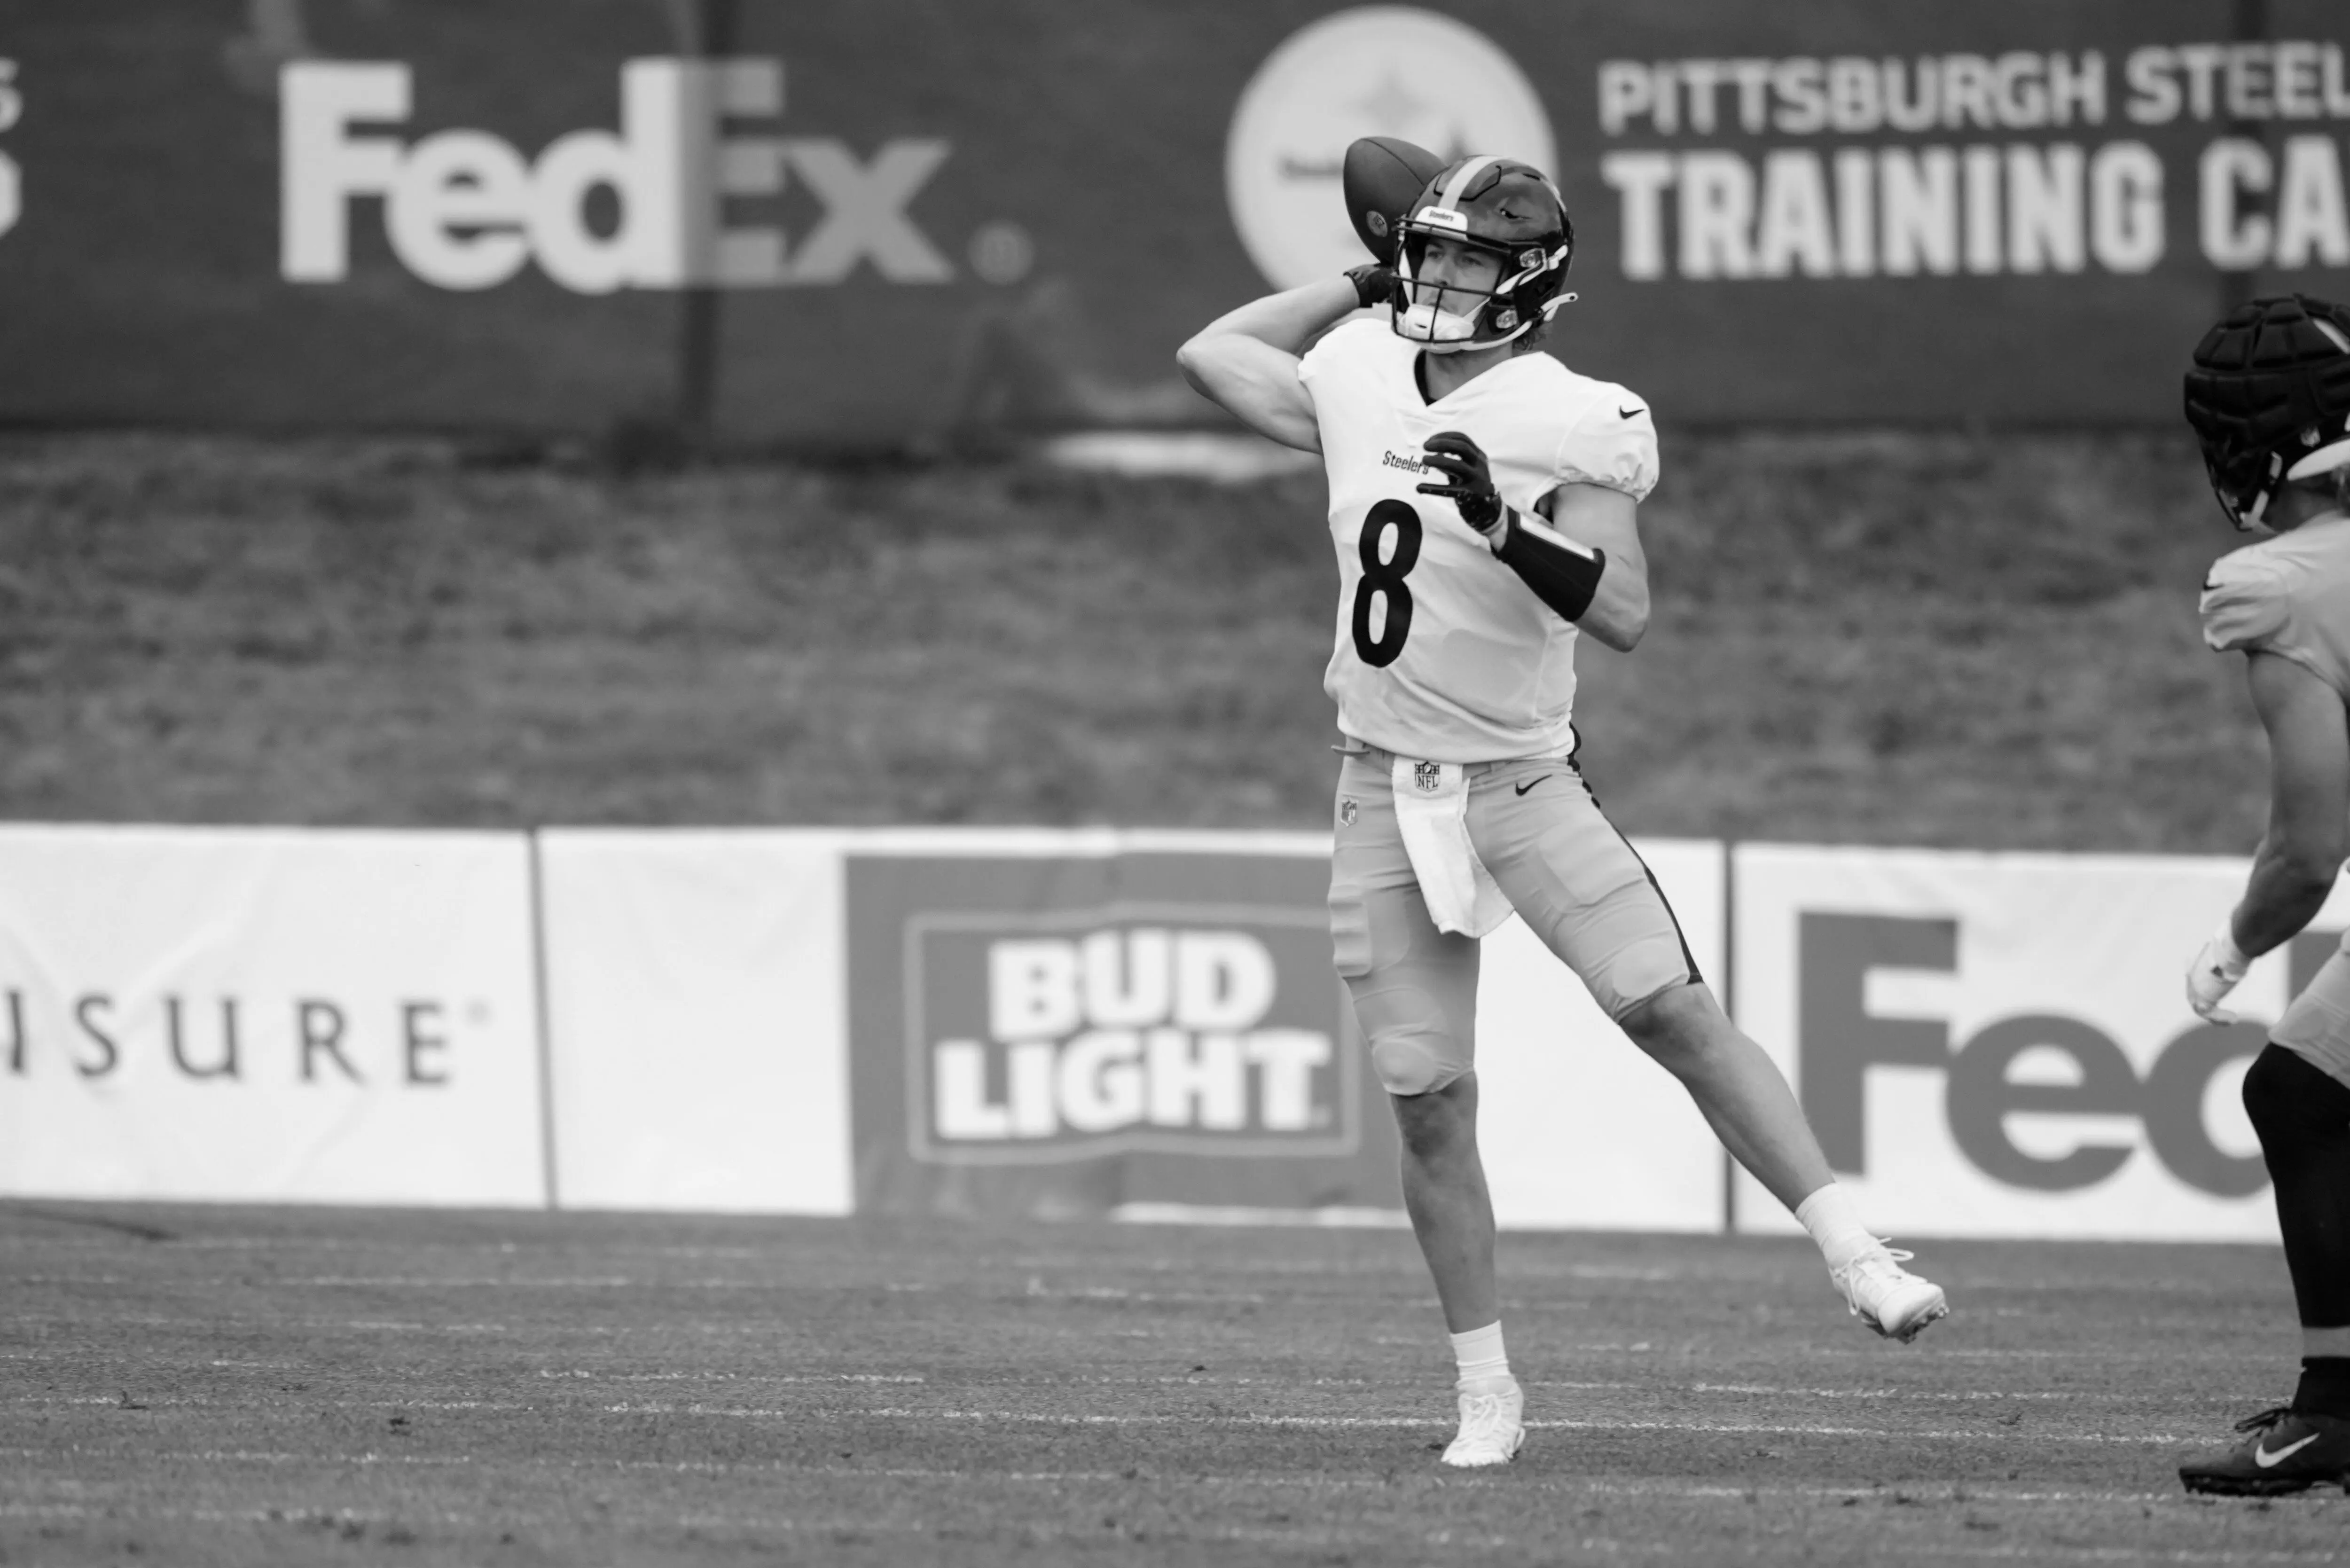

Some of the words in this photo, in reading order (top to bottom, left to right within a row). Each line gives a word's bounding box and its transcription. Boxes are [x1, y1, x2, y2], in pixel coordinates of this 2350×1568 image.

[1597, 51, 2107, 135] PITTSBURGH
[278, 55, 953, 295] FedEx
[1600, 142, 2166, 281] TRAINING
[1383, 450, 1428, 475] Steelers
[1352, 499, 1422, 668] 8
[1417, 775, 1438, 789] NFL
[5, 989, 449, 1085] ISURE
[990, 930, 1275, 1041] BUD
[936, 1029, 1330, 1138] LIGHT
